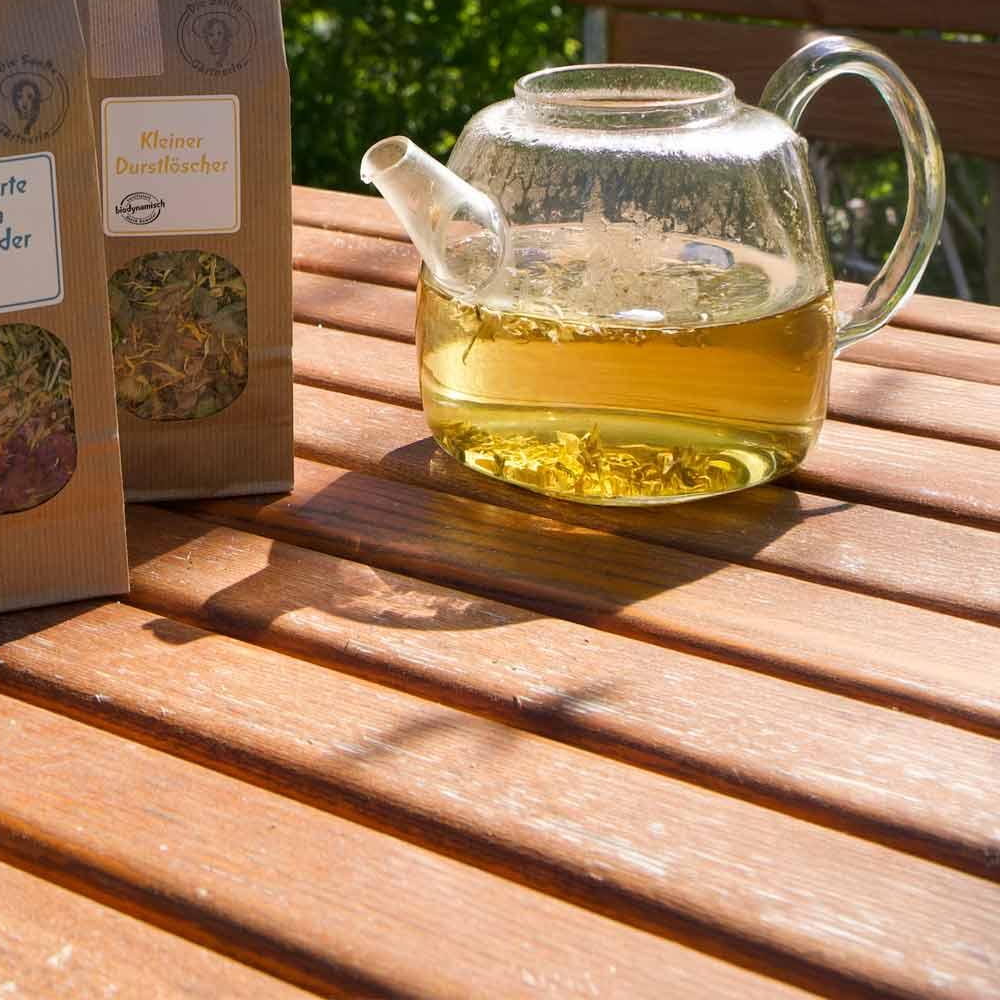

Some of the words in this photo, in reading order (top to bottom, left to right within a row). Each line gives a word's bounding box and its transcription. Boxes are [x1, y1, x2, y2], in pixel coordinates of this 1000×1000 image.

[140, 129, 205, 150] Kleiner
[115, 153, 230, 176] Durstlöscher
[115, 199, 166, 215] biodynamisch
